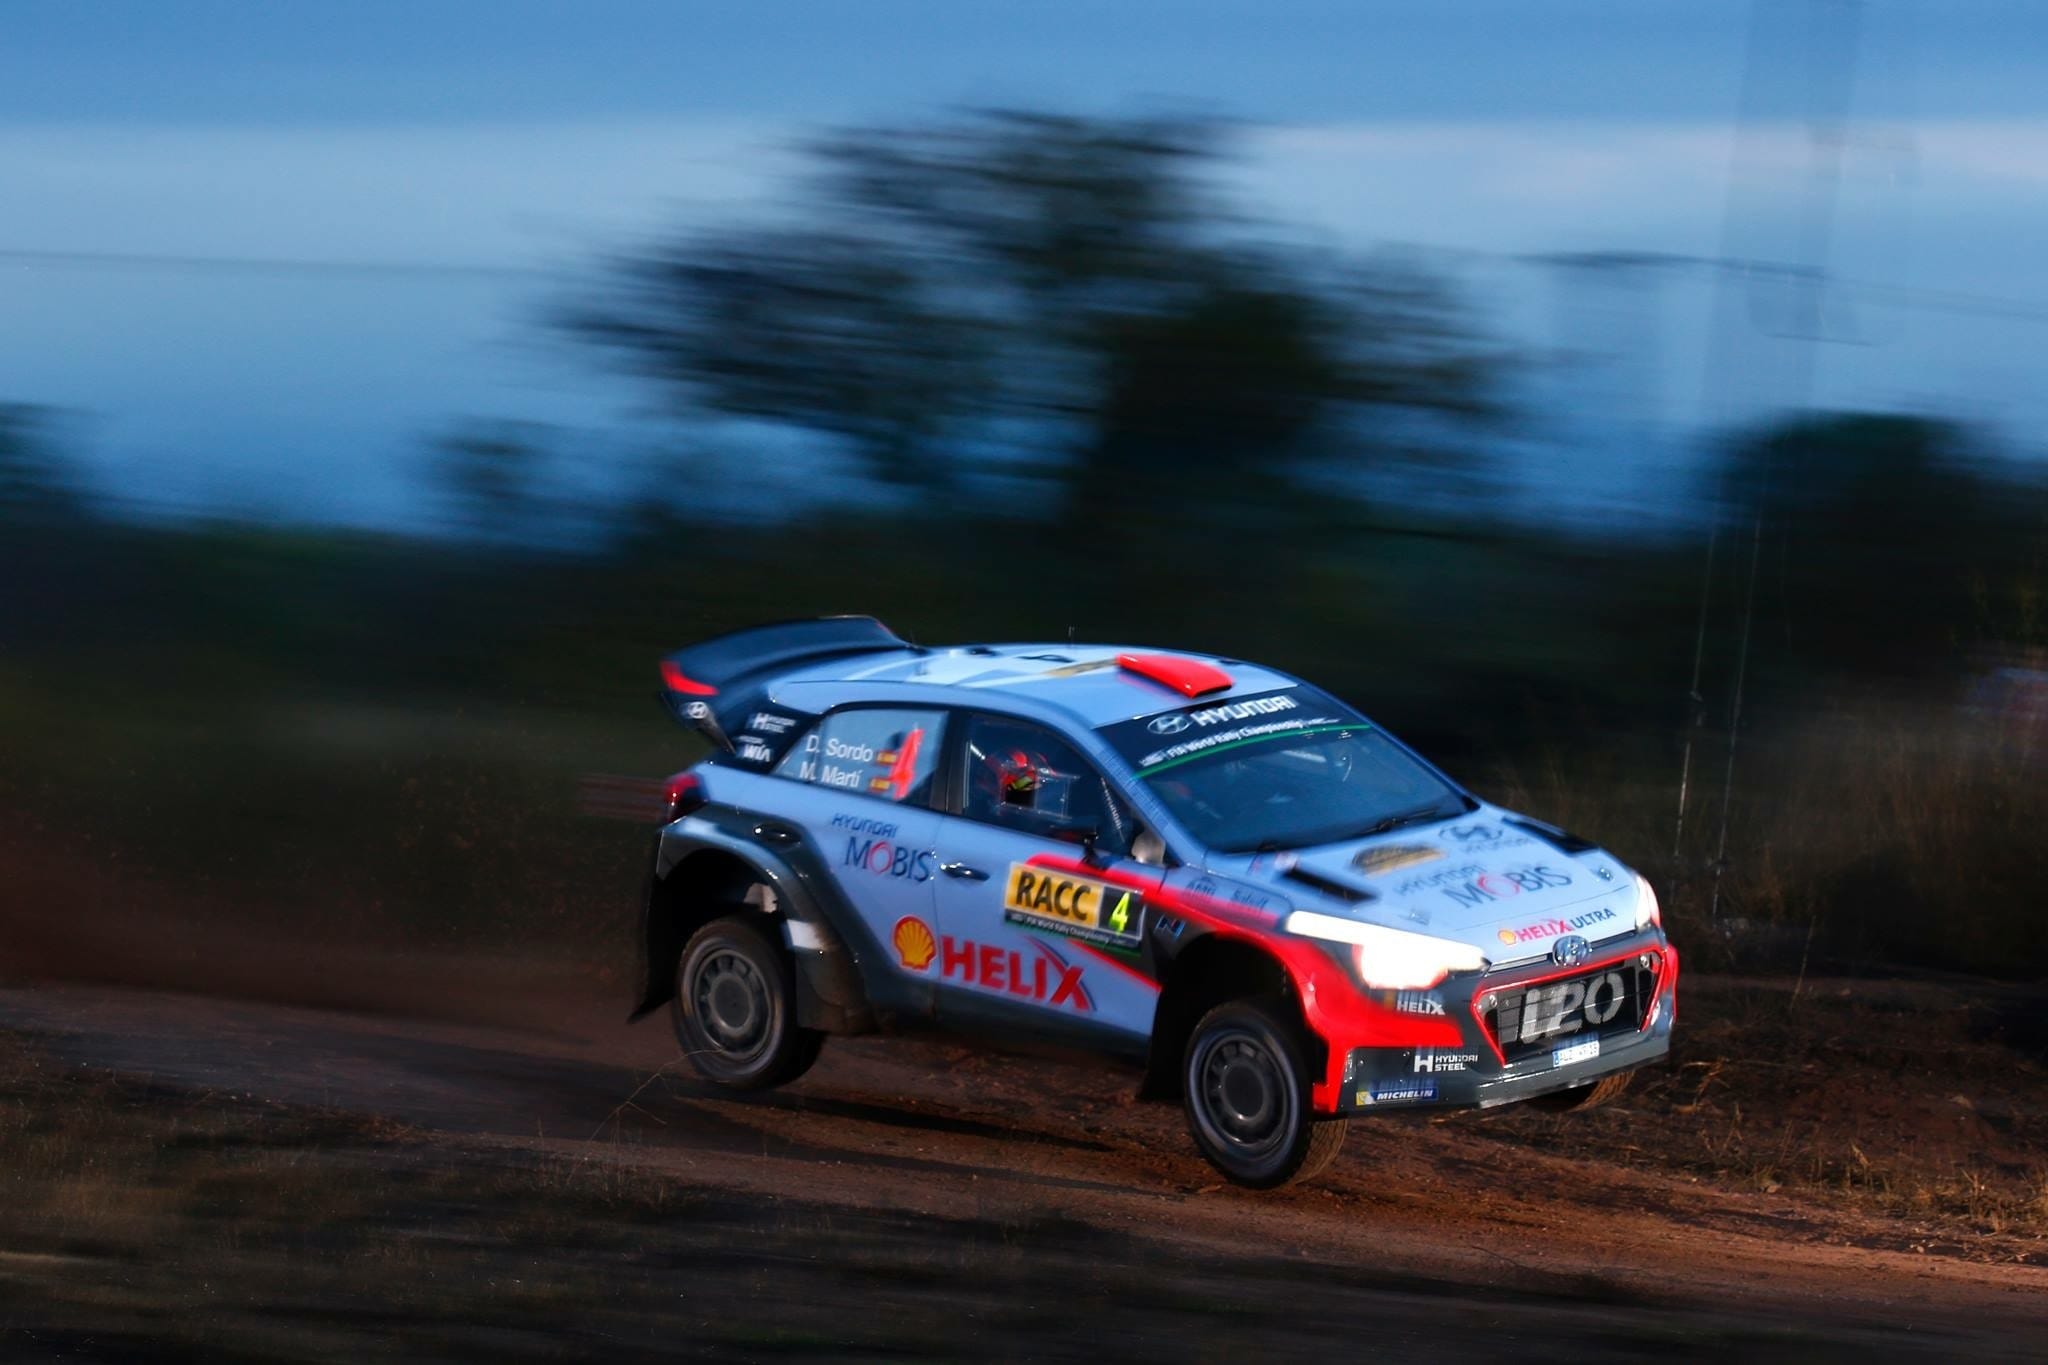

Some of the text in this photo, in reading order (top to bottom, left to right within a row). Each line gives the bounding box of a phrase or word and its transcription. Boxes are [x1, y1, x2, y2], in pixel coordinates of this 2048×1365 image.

[1190, 695, 1298, 727] HYUNDAI
[826, 738, 874, 762] Sordo
[832, 813, 898, 838] HYUNDAI
[844, 836, 933, 883] MOBIS
[1016, 871, 1091, 921] RACC
[1442, 866, 1572, 908] MOBIS
[1109, 891, 1131, 935] 4
[1515, 908, 1616, 942] HELIX ULTRA
[941, 936, 1097, 1011] HELIX
[1396, 999, 1446, 1016] HELIX
[1435, 1055, 1478, 1063] HYUNDAI
[1435, 1063, 1466, 1071] STEEL
[1376, 1090, 1433, 1100] MICHELIN
